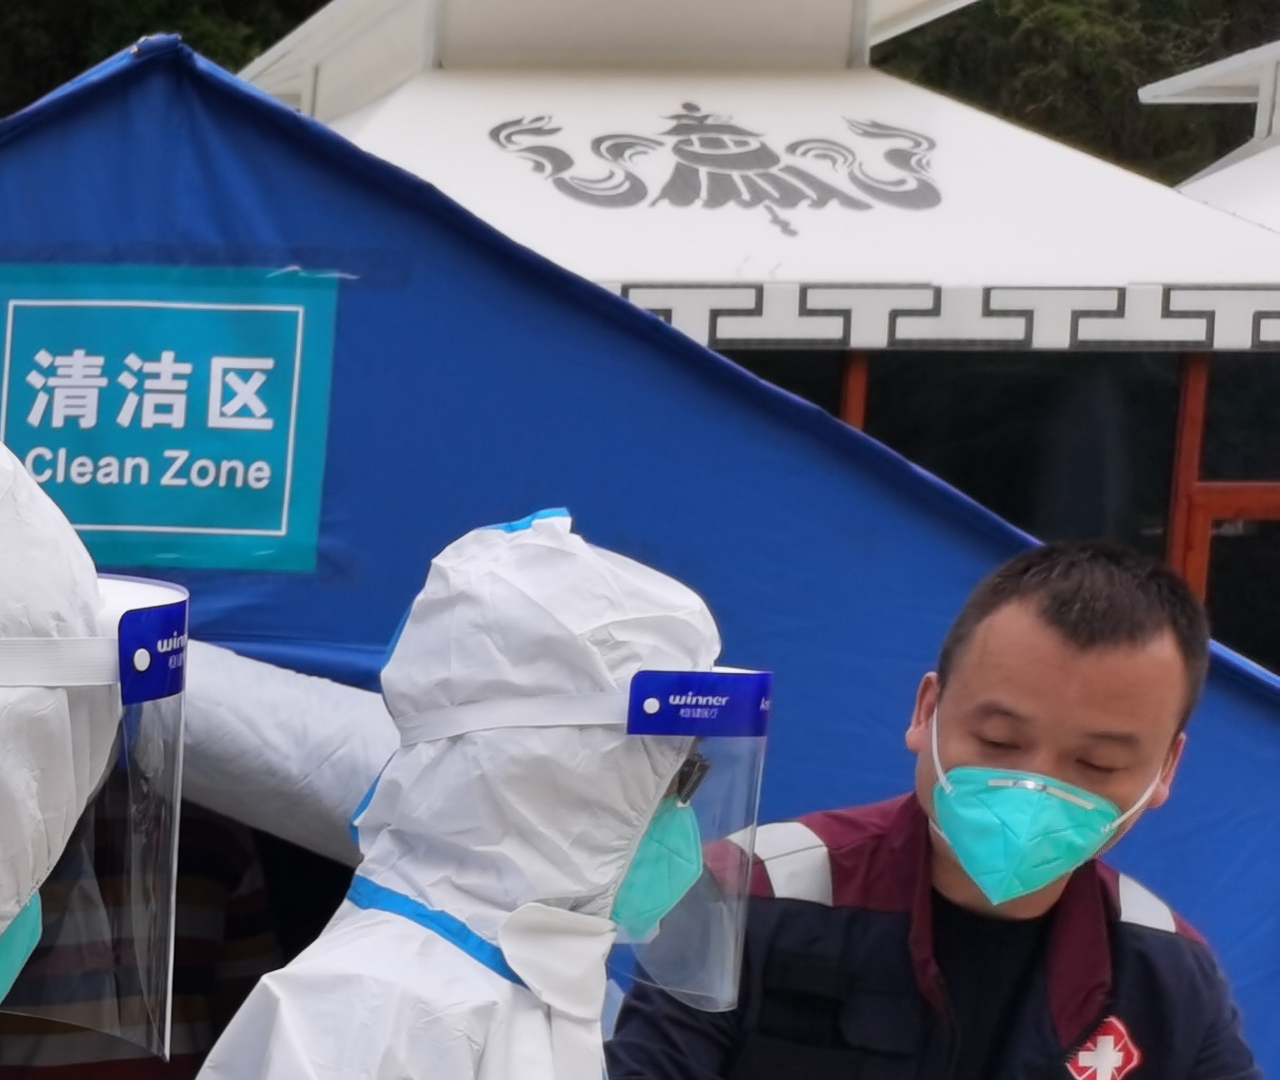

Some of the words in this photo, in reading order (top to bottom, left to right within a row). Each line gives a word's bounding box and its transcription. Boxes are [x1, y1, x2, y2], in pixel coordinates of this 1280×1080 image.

[26, 349, 275, 431] 清洁区
[25, 447, 150, 486] Clean
[160, 450, 272, 489] Zone
[668, 691, 730, 706] winner
